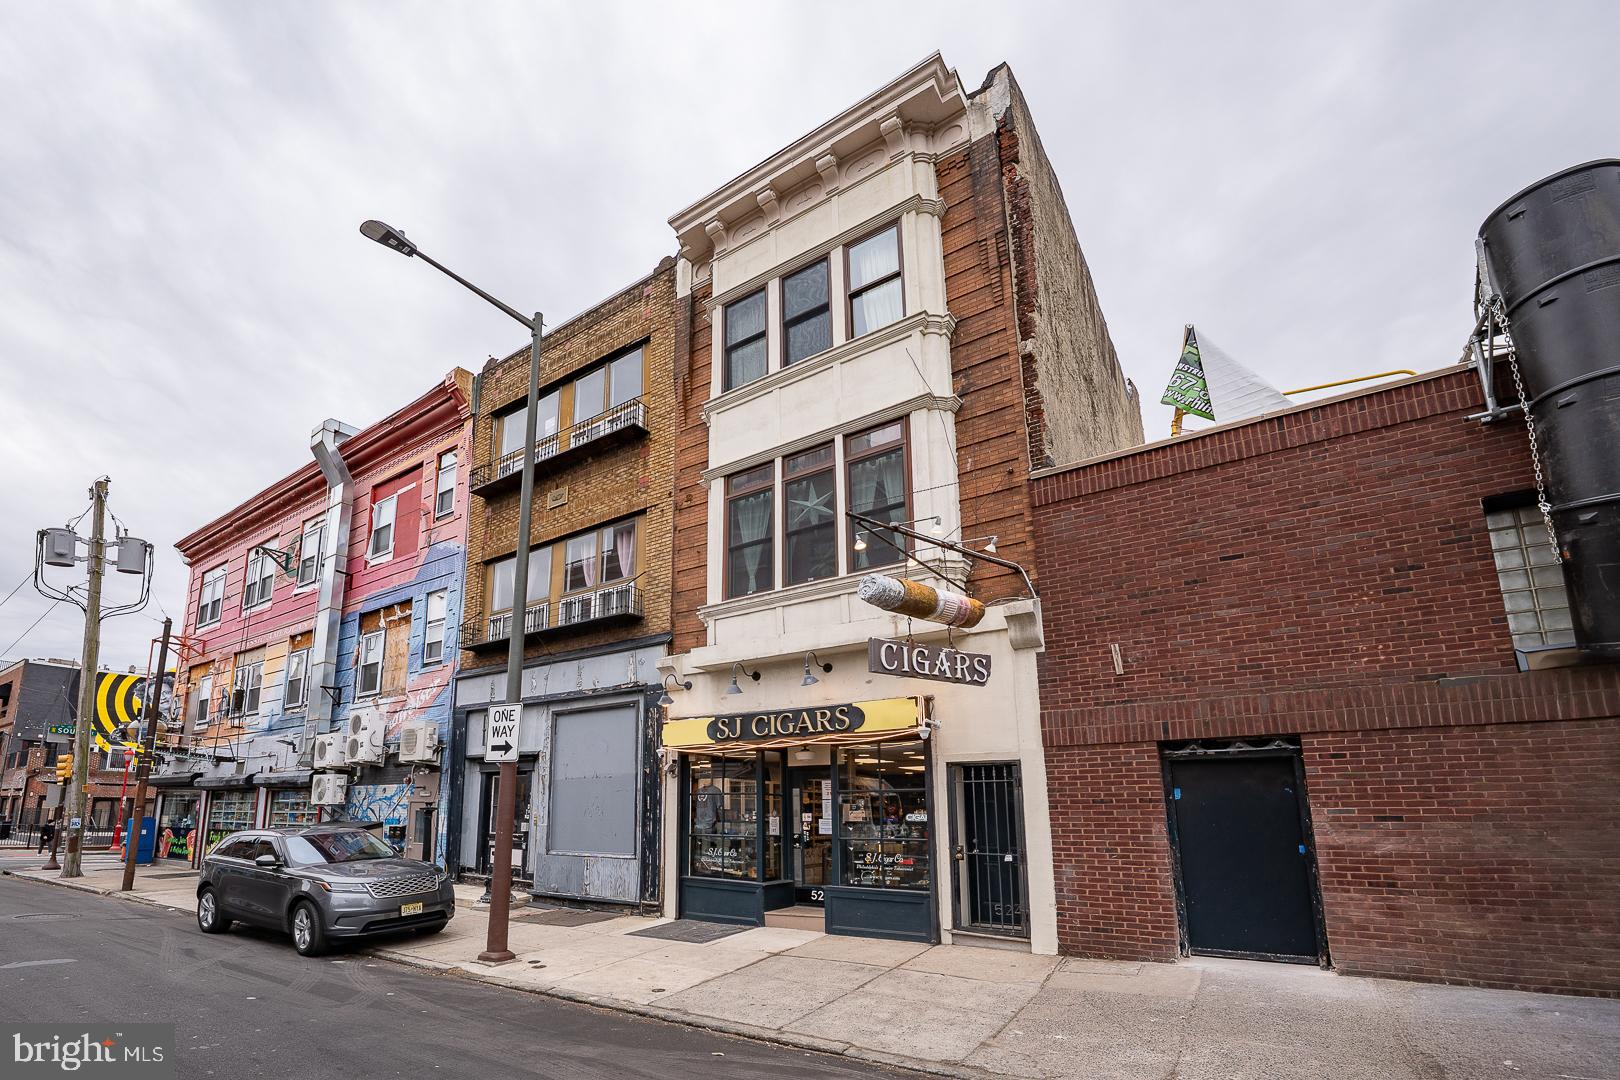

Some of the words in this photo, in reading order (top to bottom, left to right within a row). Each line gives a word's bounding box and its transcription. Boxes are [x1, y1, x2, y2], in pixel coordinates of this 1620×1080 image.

[880, 643, 988, 682] CIGARS
[493, 709, 516, 723] ONE
[716, 717, 743, 739] SJ
[751, 706, 851, 737] CIGARS
[57, 727, 76, 735] SOU
[492, 724, 516, 738] WAY
[810, 890, 825, 901] 52
